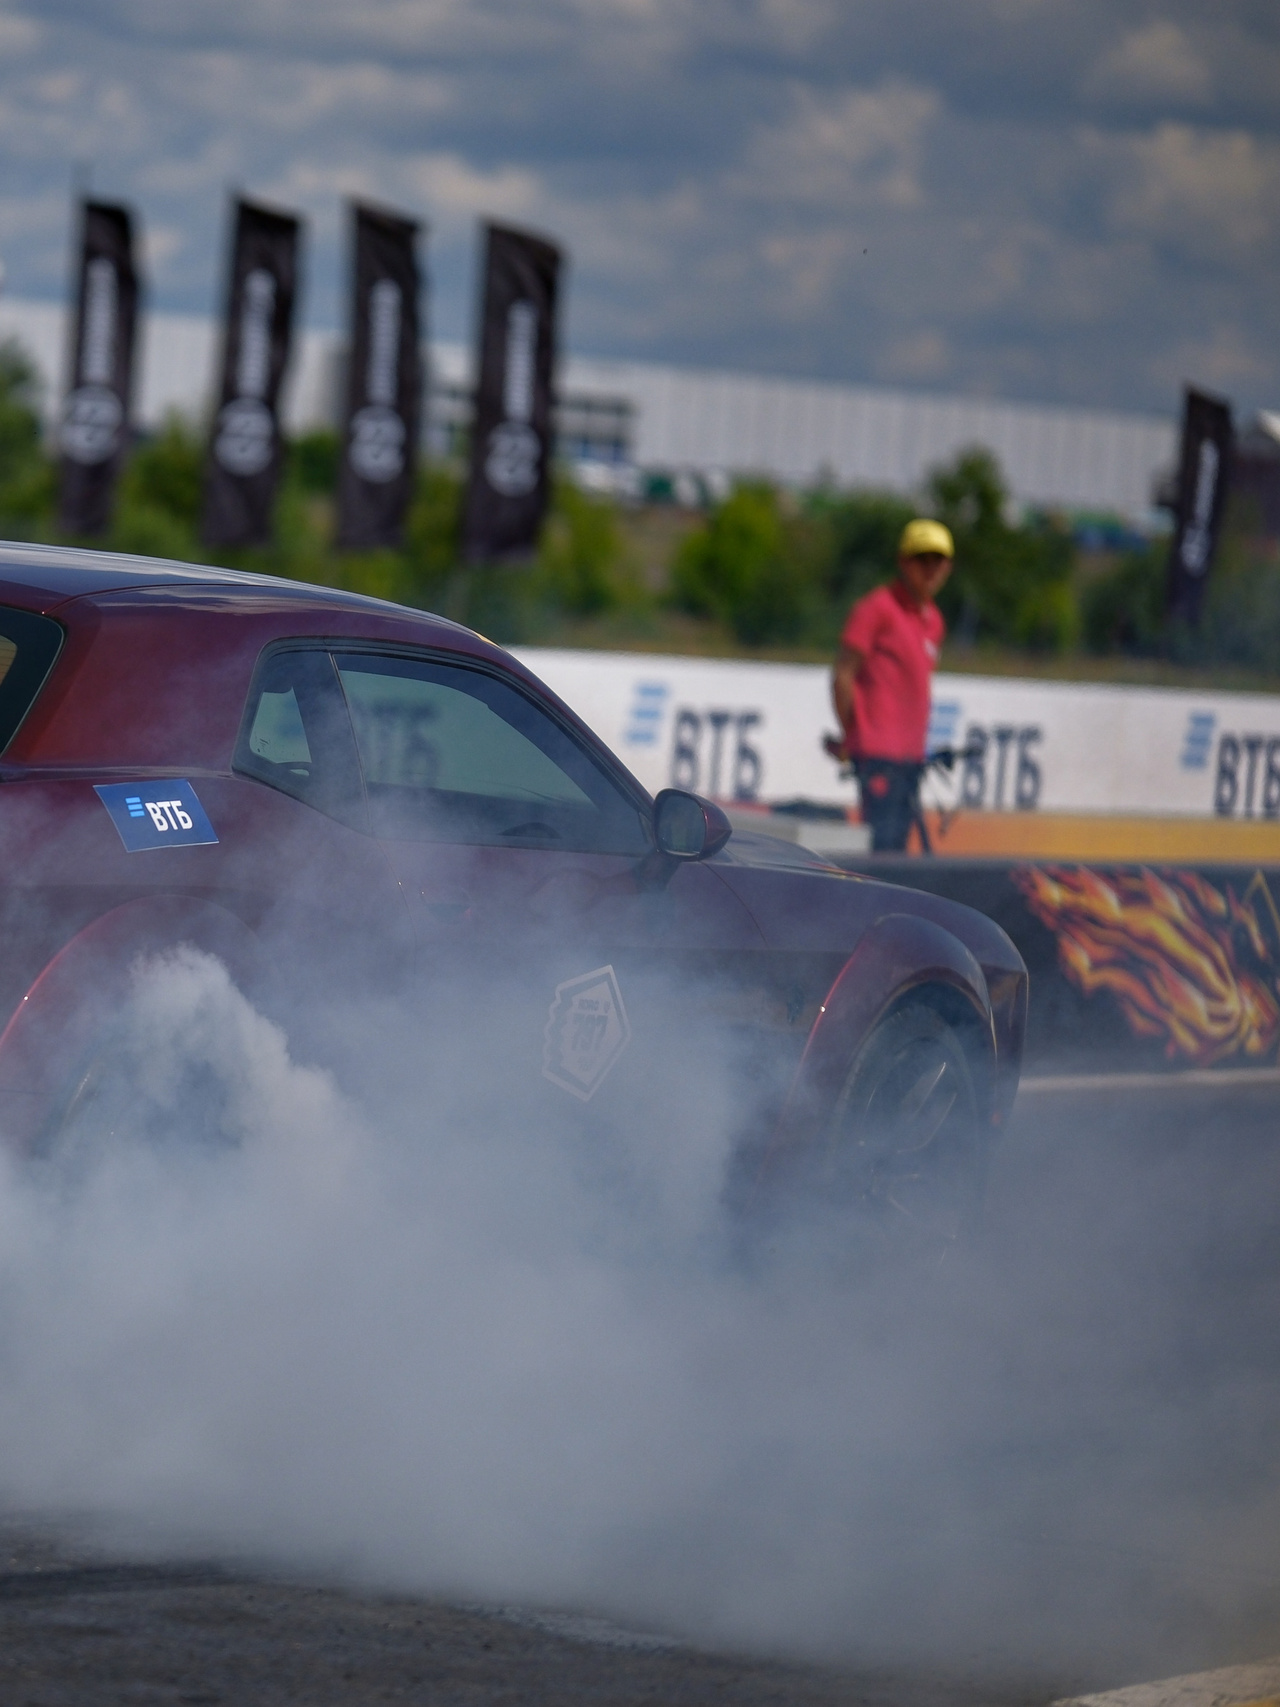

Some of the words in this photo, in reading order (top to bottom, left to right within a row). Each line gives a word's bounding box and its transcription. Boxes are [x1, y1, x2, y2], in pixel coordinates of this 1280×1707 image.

[673, 706, 763, 800] ВТБ
[964, 722, 1044, 810] ВТБ
[144, 800, 193, 832] ВТБ
